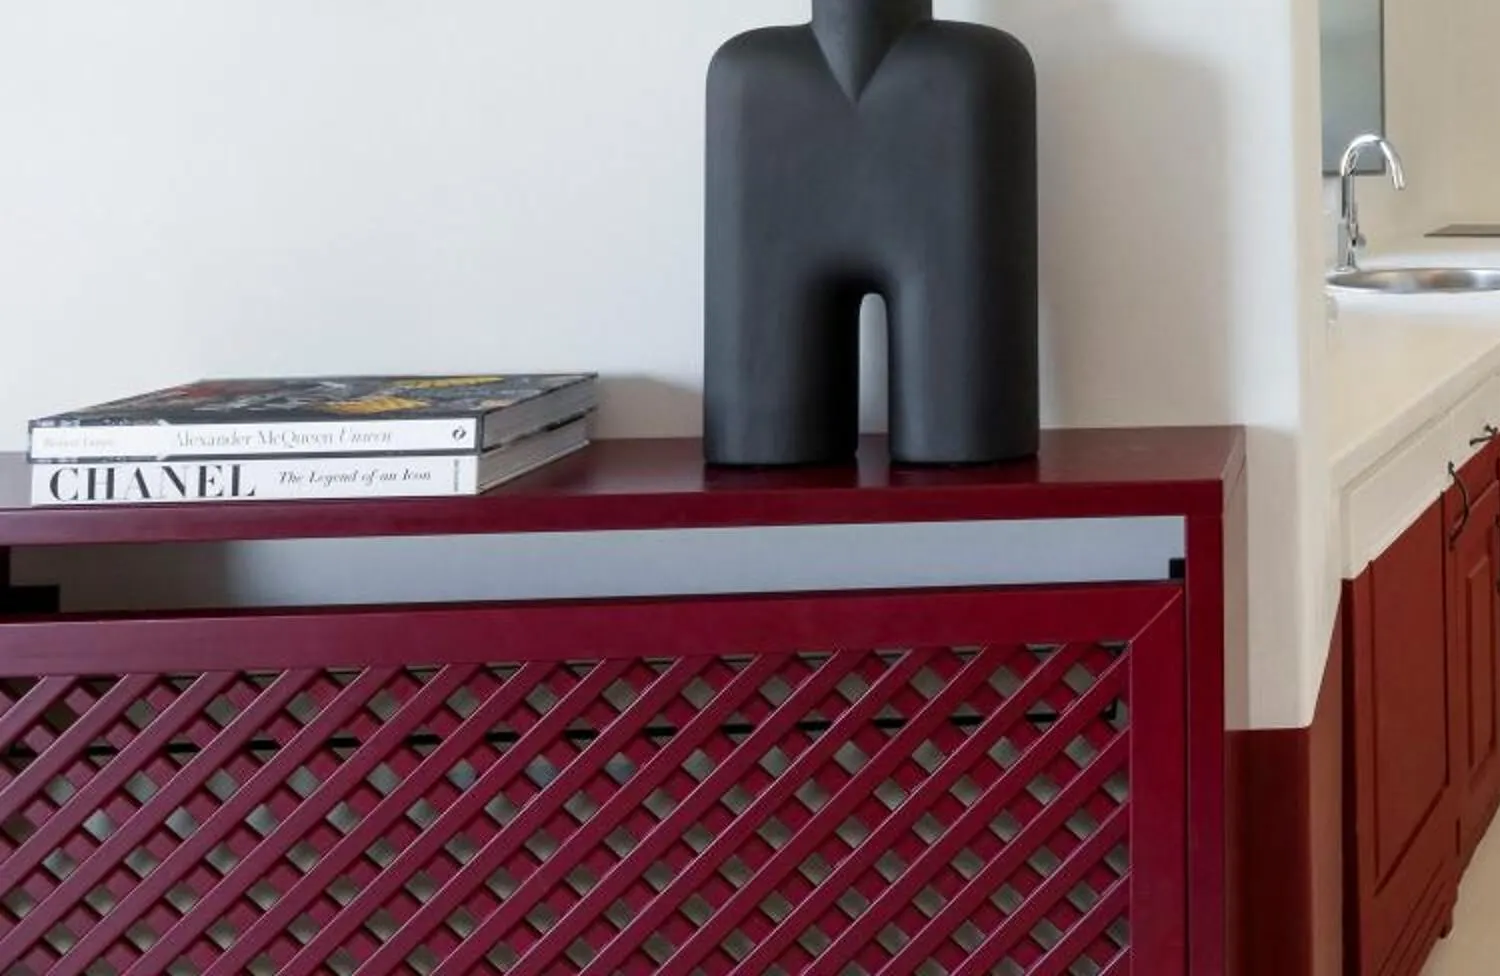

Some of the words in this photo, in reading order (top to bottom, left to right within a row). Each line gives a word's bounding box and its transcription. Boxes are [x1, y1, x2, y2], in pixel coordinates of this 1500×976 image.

[177, 428, 251, 448] Alexander
[258, 428, 333, 448] McQueen
[49, 464, 256, 502] CHANEL
[279, 470, 304, 485] The
[308, 469, 359, 487] Legend
[361, 468, 379, 486] of
[379, 473, 398, 482] an
[402, 468, 432, 482] Icon
